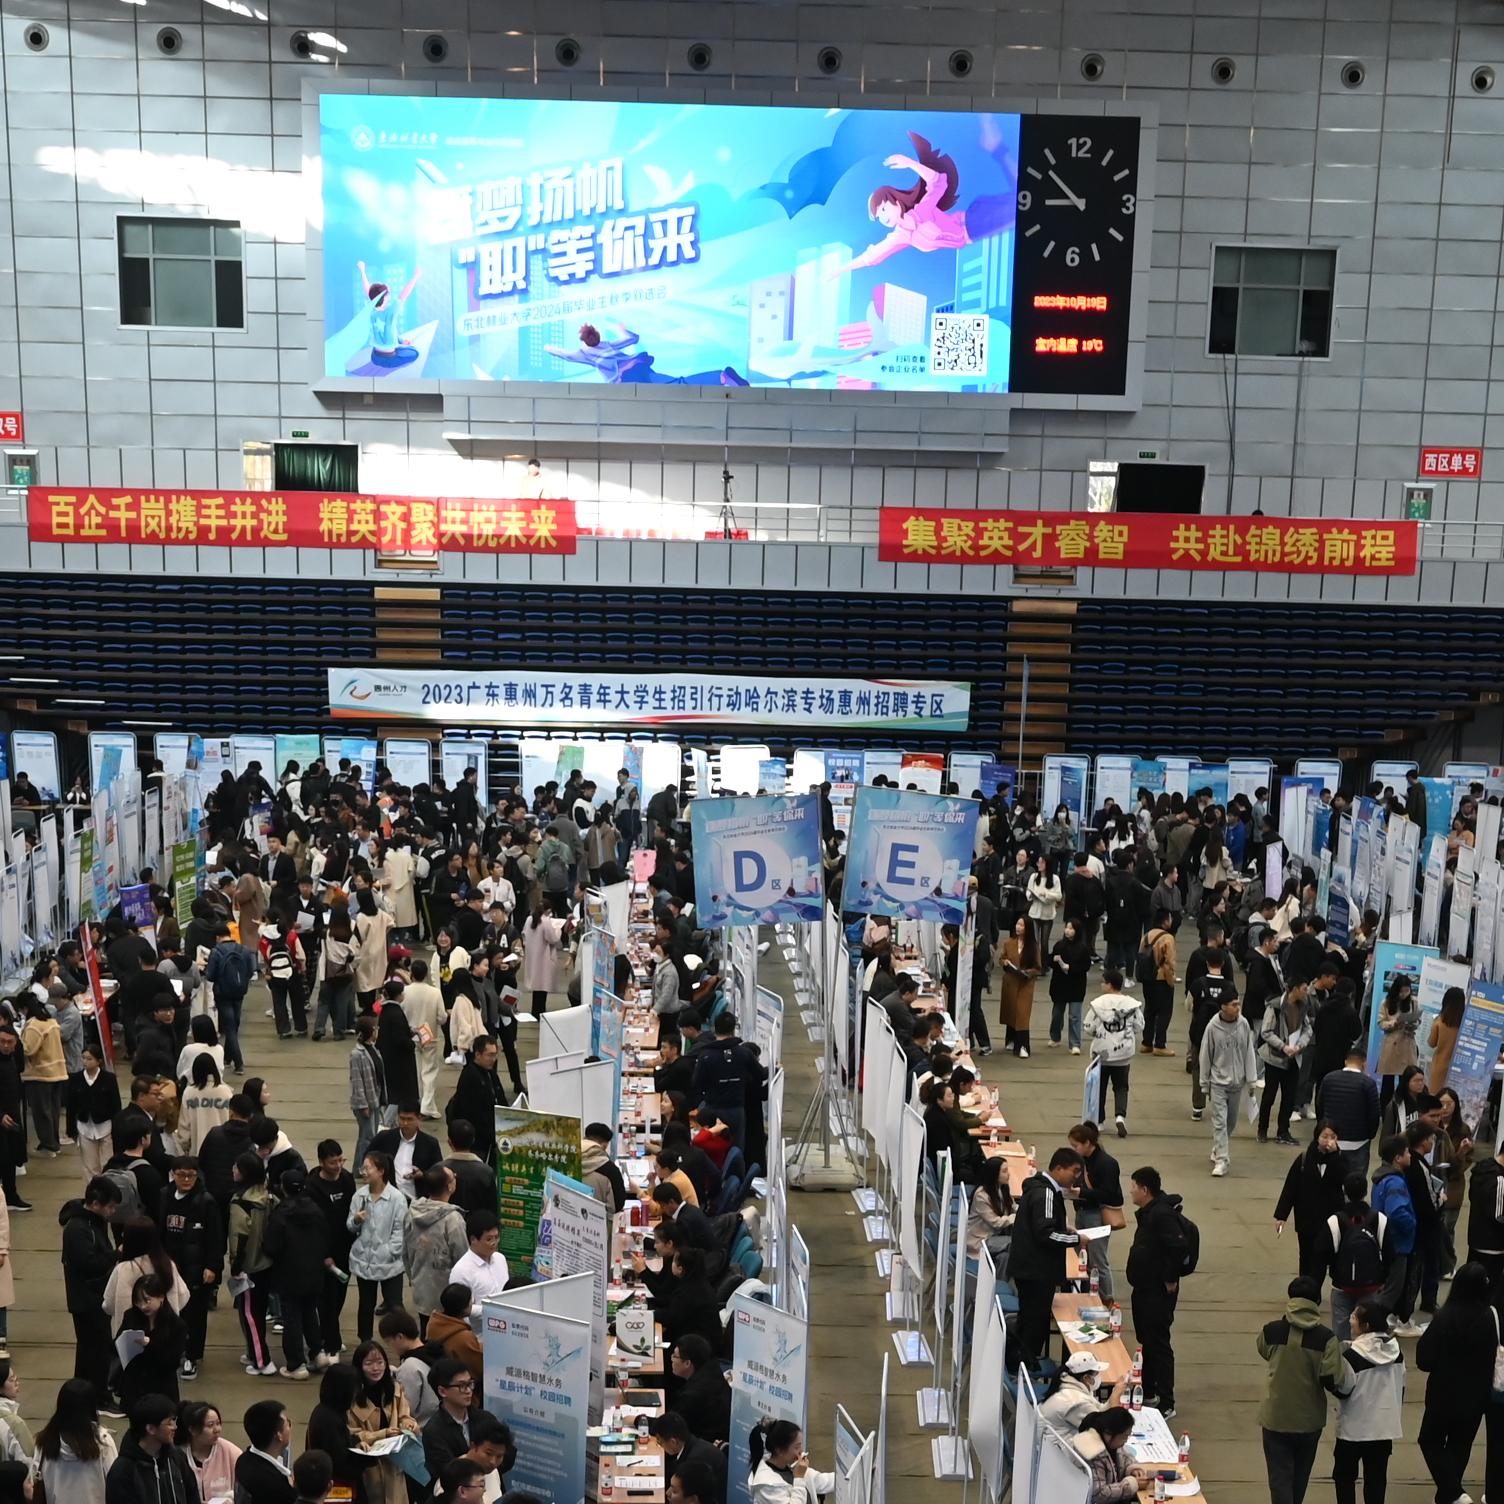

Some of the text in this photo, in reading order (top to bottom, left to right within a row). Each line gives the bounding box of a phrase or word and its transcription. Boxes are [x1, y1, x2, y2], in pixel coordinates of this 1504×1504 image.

[1068, 137, 1092, 158] 12
[431, 157, 624, 240] 梦扬帆
[1018, 190, 1032, 210] 9
[1121, 195, 1136, 214] 3
[1065, 246, 1080, 267] 6
[1424, 453, 1478, 474] 西区单号
[48, 494, 559, 548] 百企千岗携手并进 精英齐聚共悦未来
[902, 515, 1397, 568] 集聚英才睿智 共赴锦绣前程
[421, 680, 946, 719] 2023广东惠州万名青年大学生招引行动哈尔滨专场惠州招聘专区
[499, 934, 509, 948] A
[506, 1366, 563, 1389] 威派格智慧水务
[747, 1359, 788, 1386] 威派格智慧水务
[540, 1389, 572, 1408] 校园招聘
